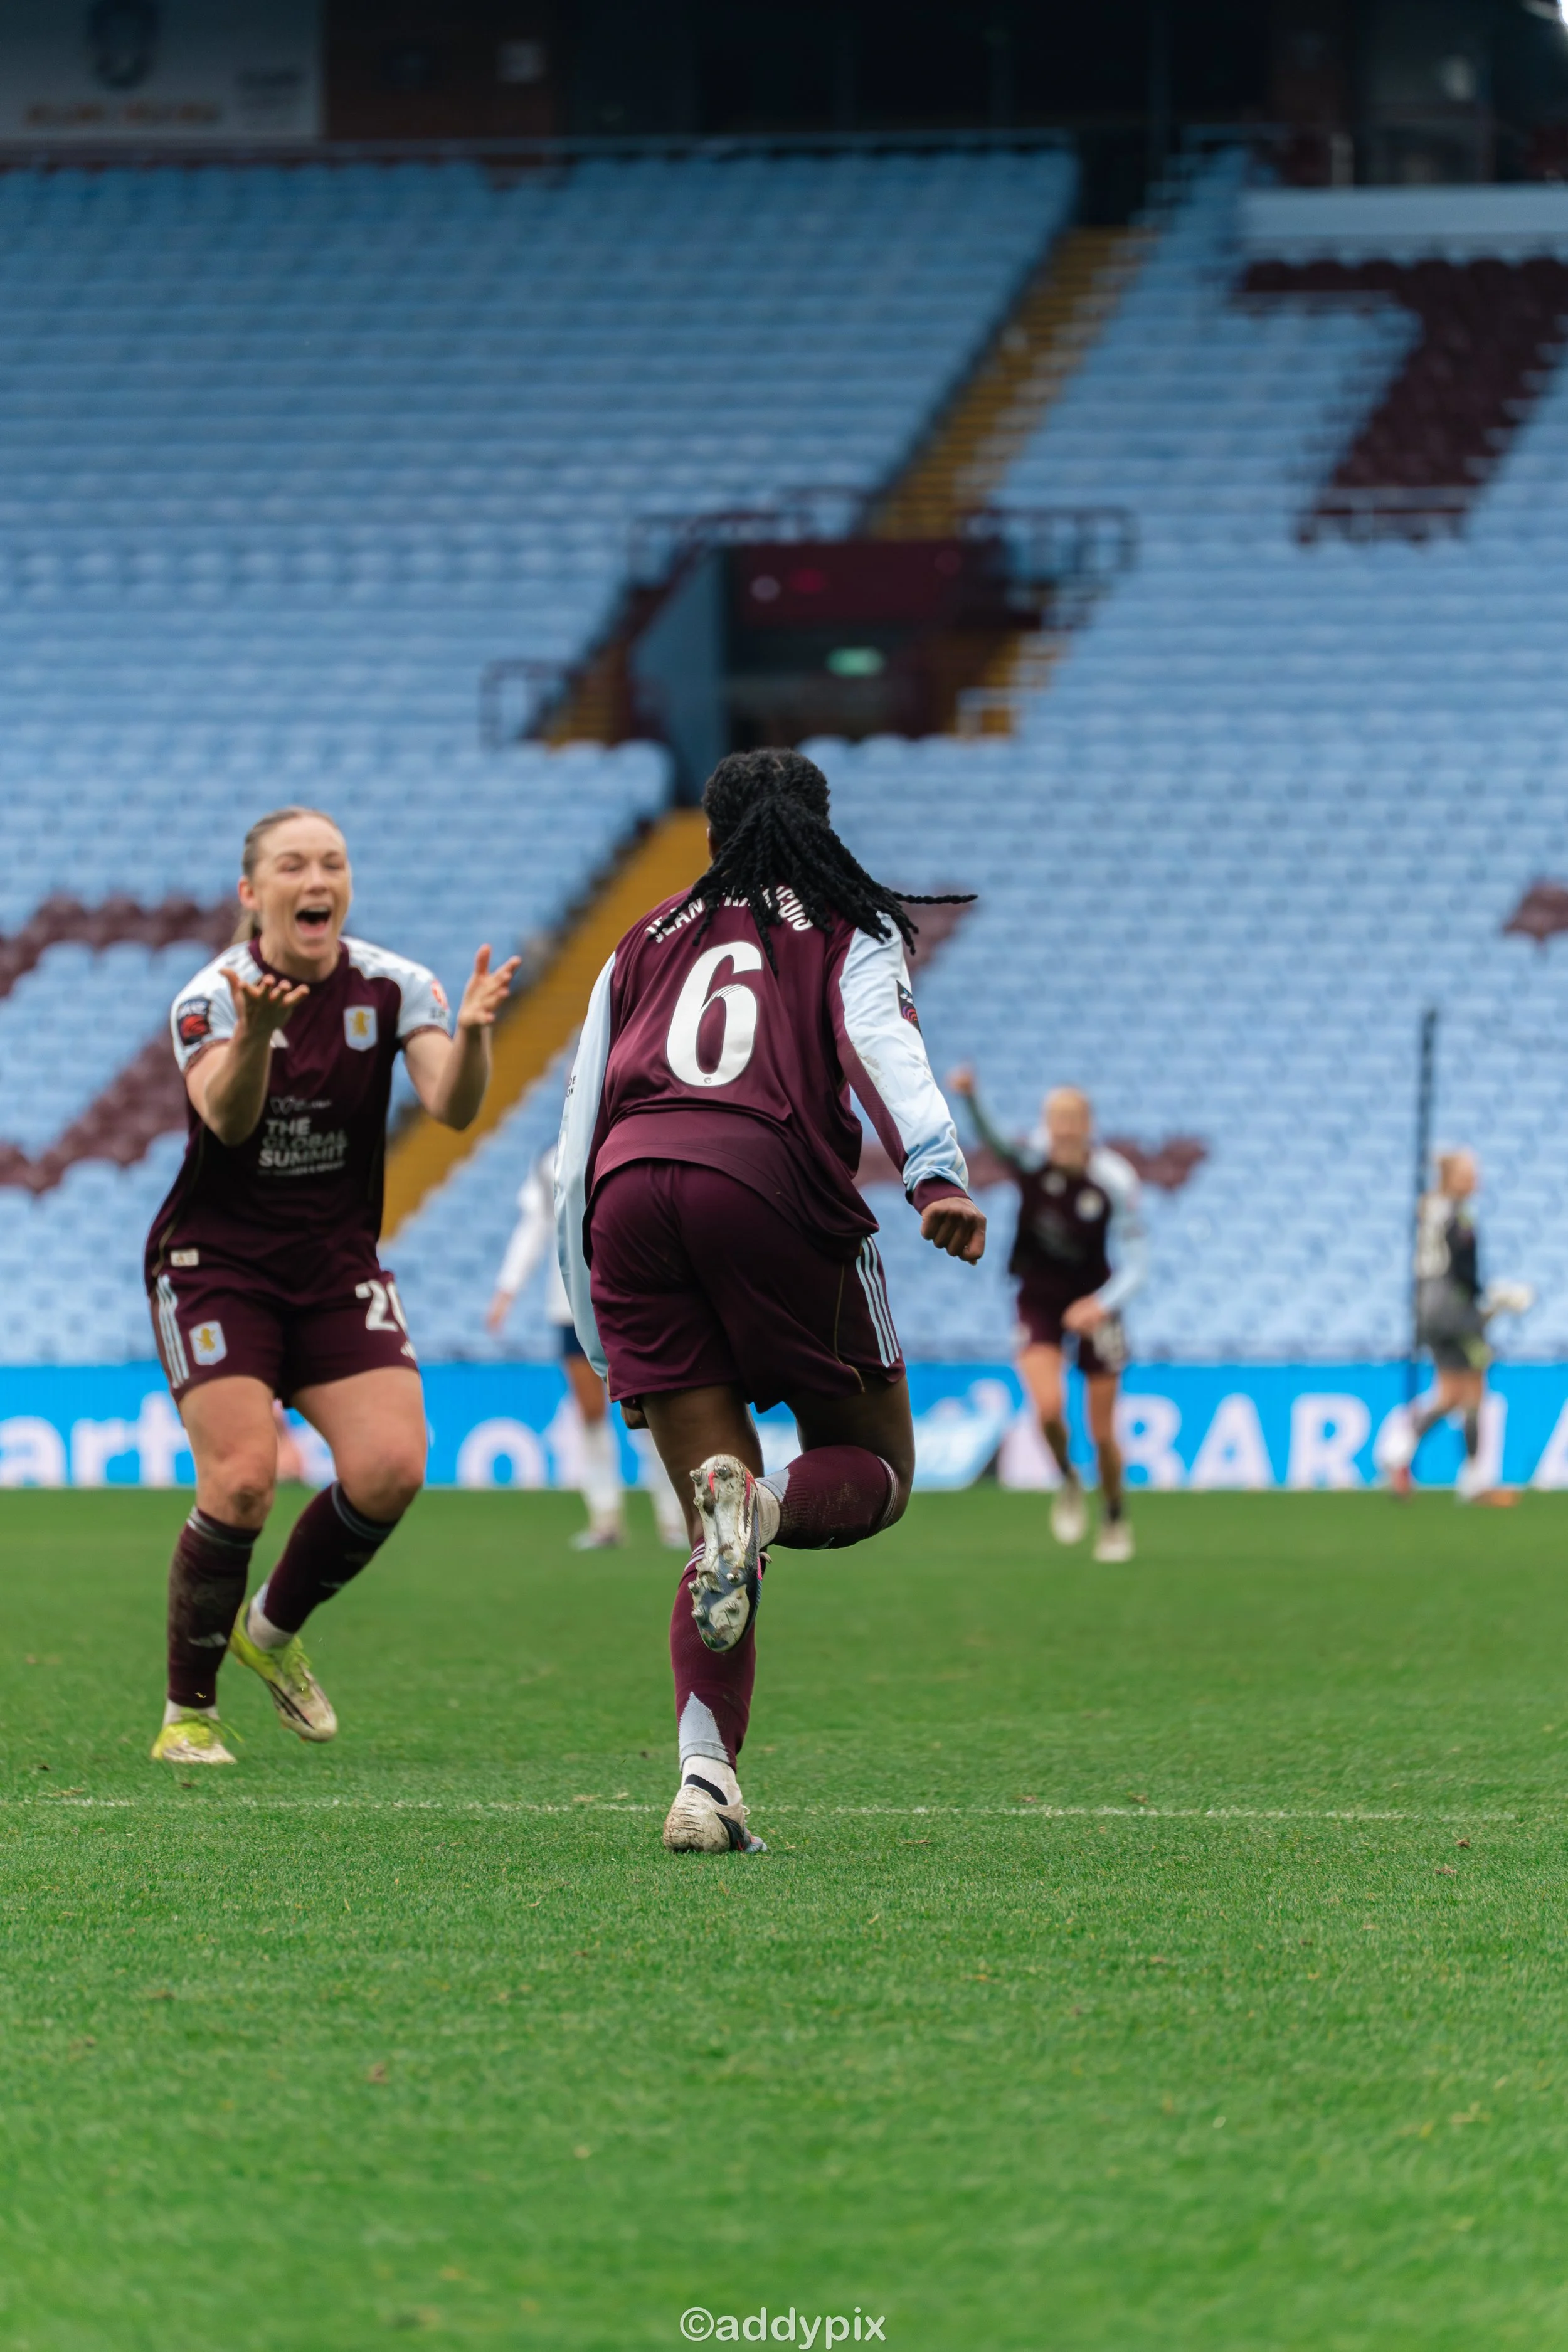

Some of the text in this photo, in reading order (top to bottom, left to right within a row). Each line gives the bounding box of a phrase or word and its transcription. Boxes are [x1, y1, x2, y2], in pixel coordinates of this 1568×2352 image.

[665, 941, 763, 1088] 6
[265, 1116, 312, 1137] THE
[258, 1144, 345, 1168] SUMMIT
